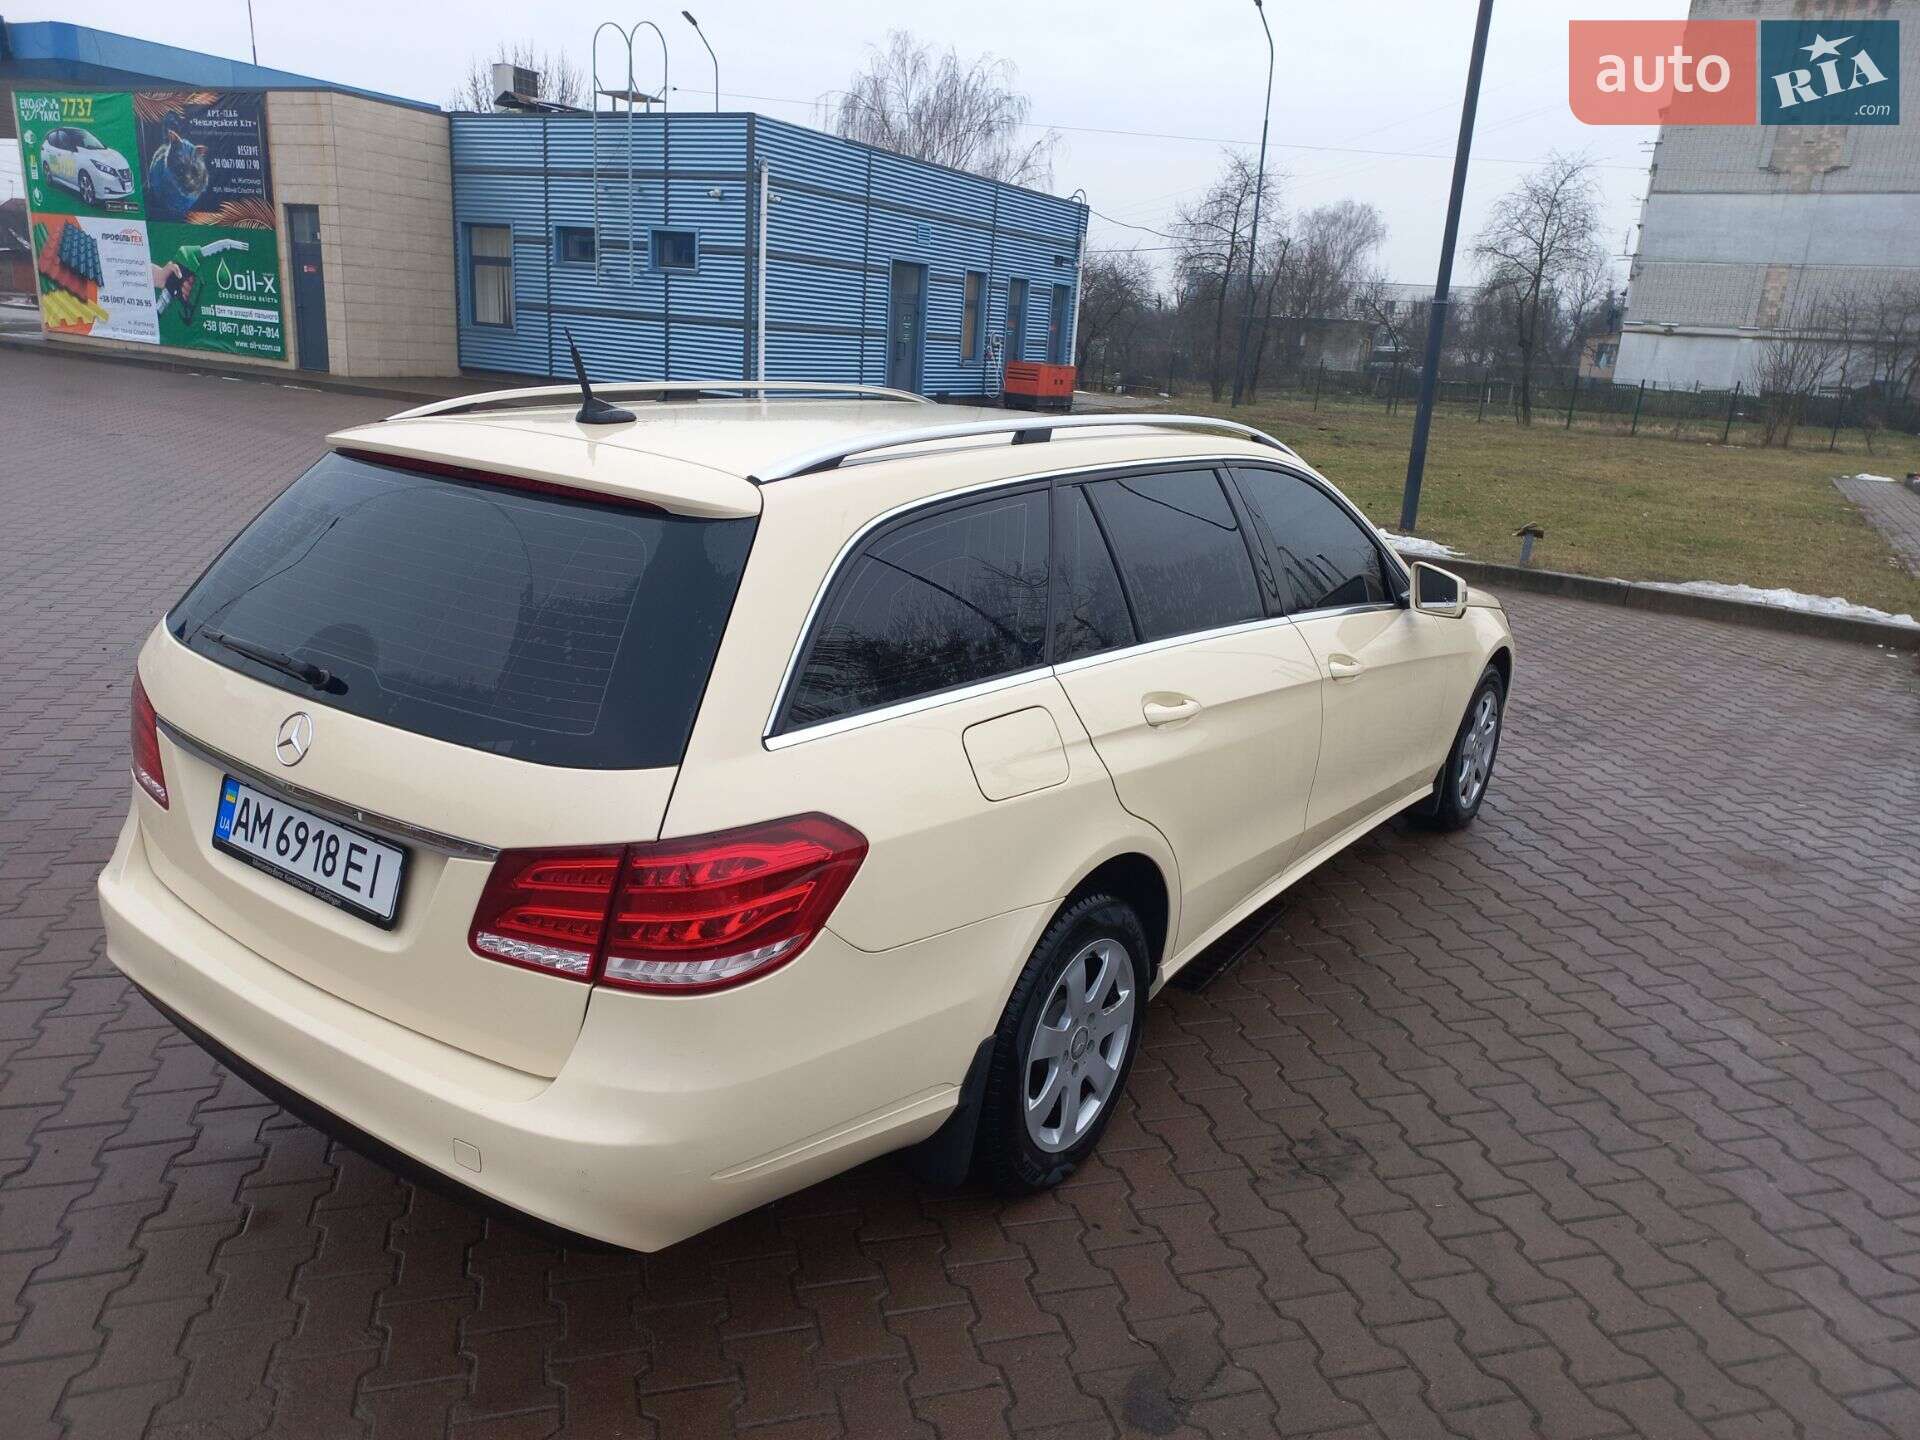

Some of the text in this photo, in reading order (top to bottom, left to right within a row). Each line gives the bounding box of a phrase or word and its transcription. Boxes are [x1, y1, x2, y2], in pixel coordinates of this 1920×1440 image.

[61, 97, 94, 117] 7737
[207, 109, 238, 117] АРТ-ПАБ
[234, 270, 276, 294] oil-x
[202, 320, 280, 339] +38 (067) 410-7-014
[219, 815, 230, 831] UA
[232, 797, 382, 899] AM 6918 EI
